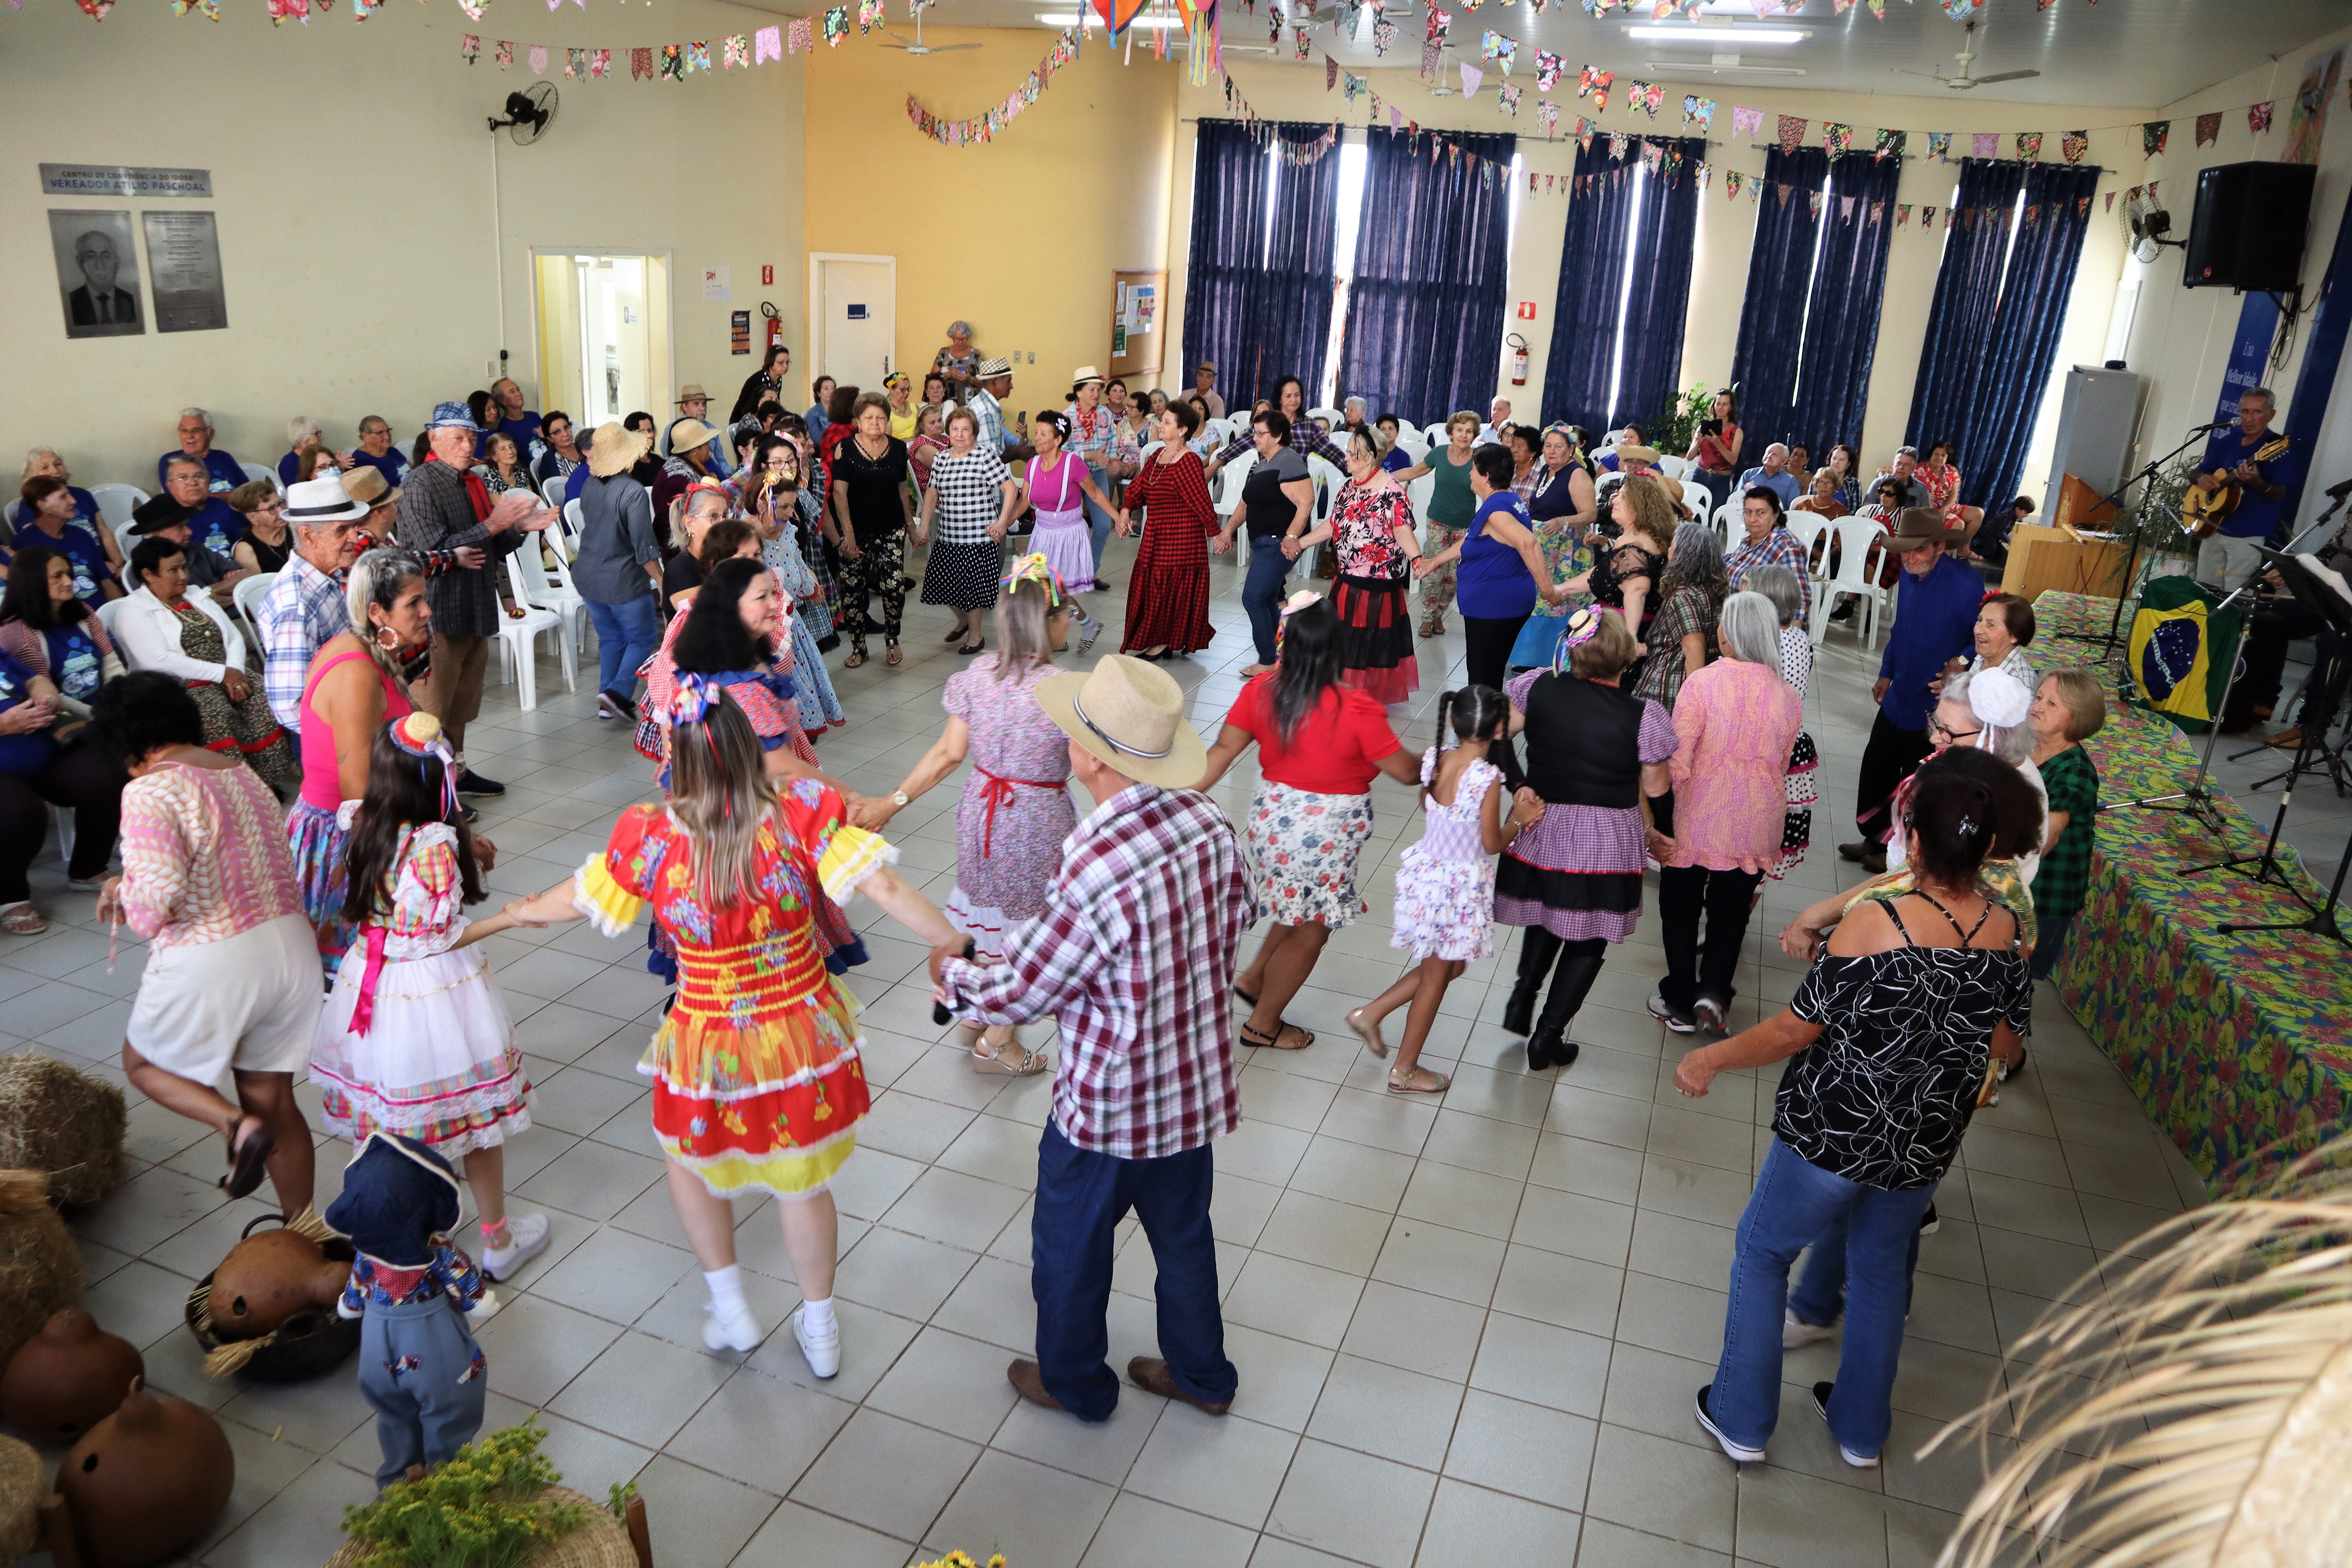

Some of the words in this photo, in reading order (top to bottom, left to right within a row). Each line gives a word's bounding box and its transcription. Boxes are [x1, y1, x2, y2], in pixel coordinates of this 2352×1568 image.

[50, 179, 110, 189] VEREADOR
[151, 182, 205, 191] PASCHOAL
[2226, 368, 2243, 384] Melhor
